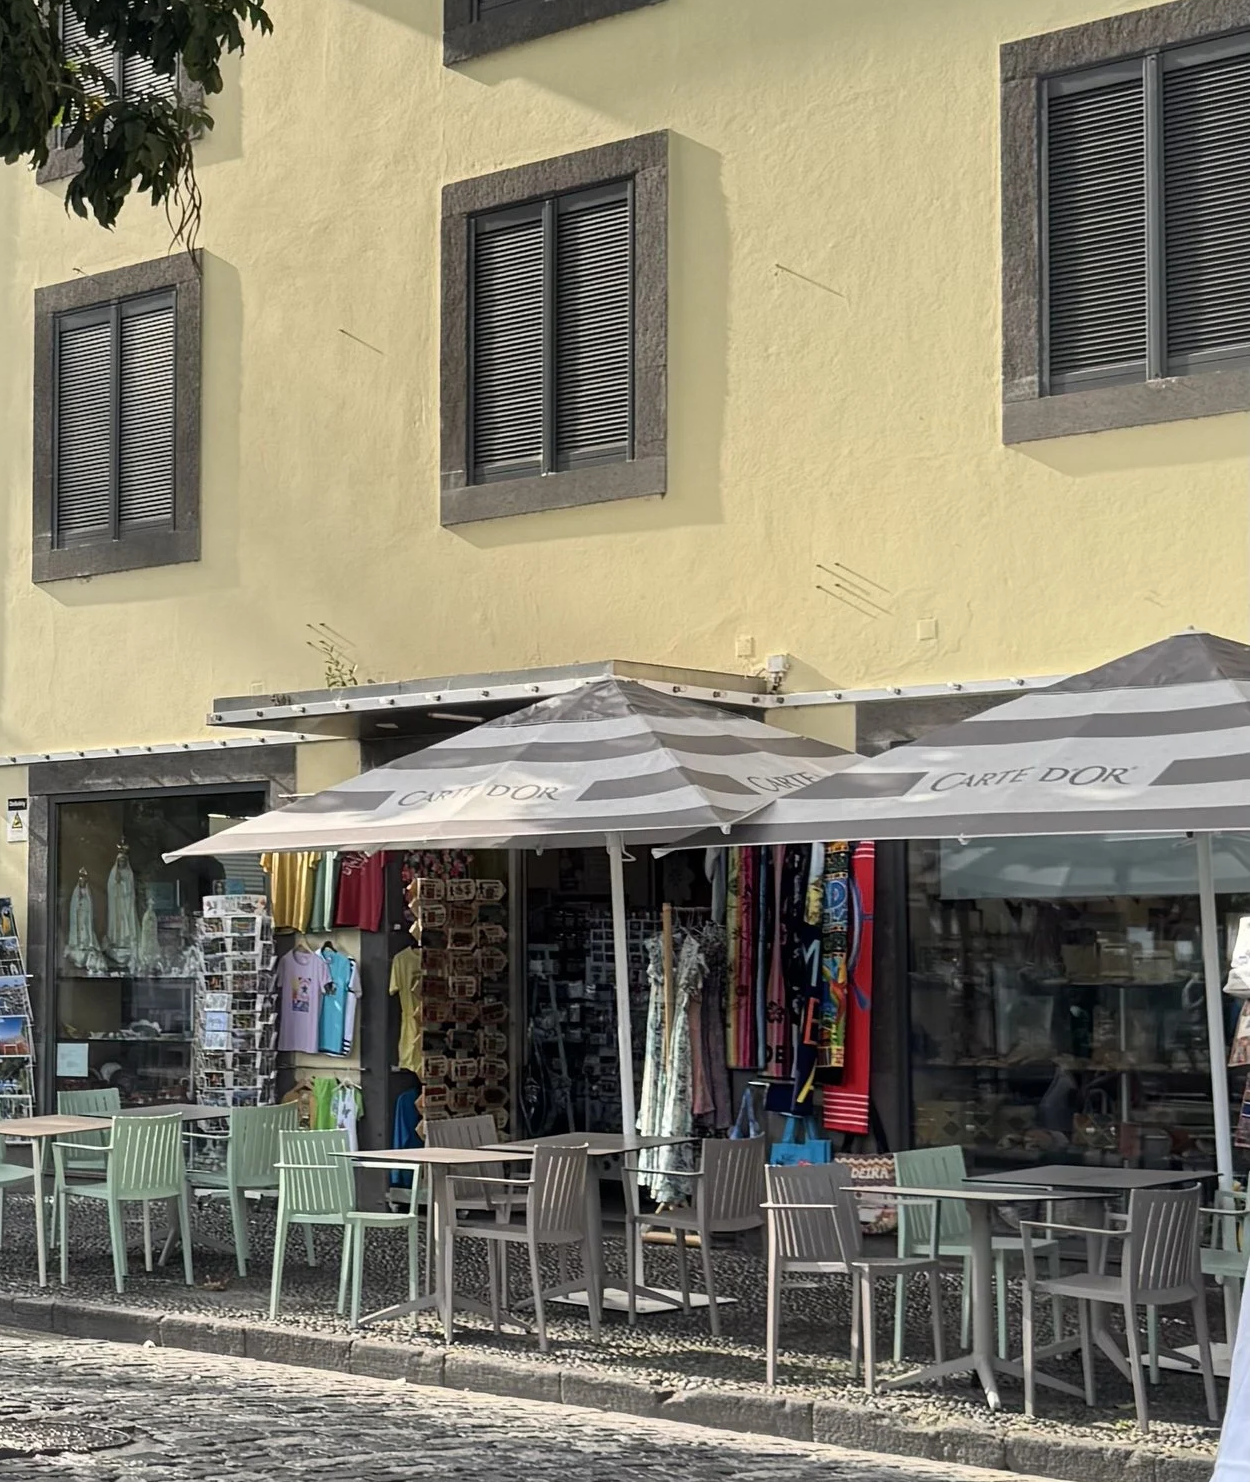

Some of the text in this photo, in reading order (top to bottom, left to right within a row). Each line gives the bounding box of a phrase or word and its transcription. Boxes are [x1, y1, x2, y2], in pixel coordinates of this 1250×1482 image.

[931, 765, 1131, 792] CARTE D'OR
[487, 784, 560, 801] D'OR
